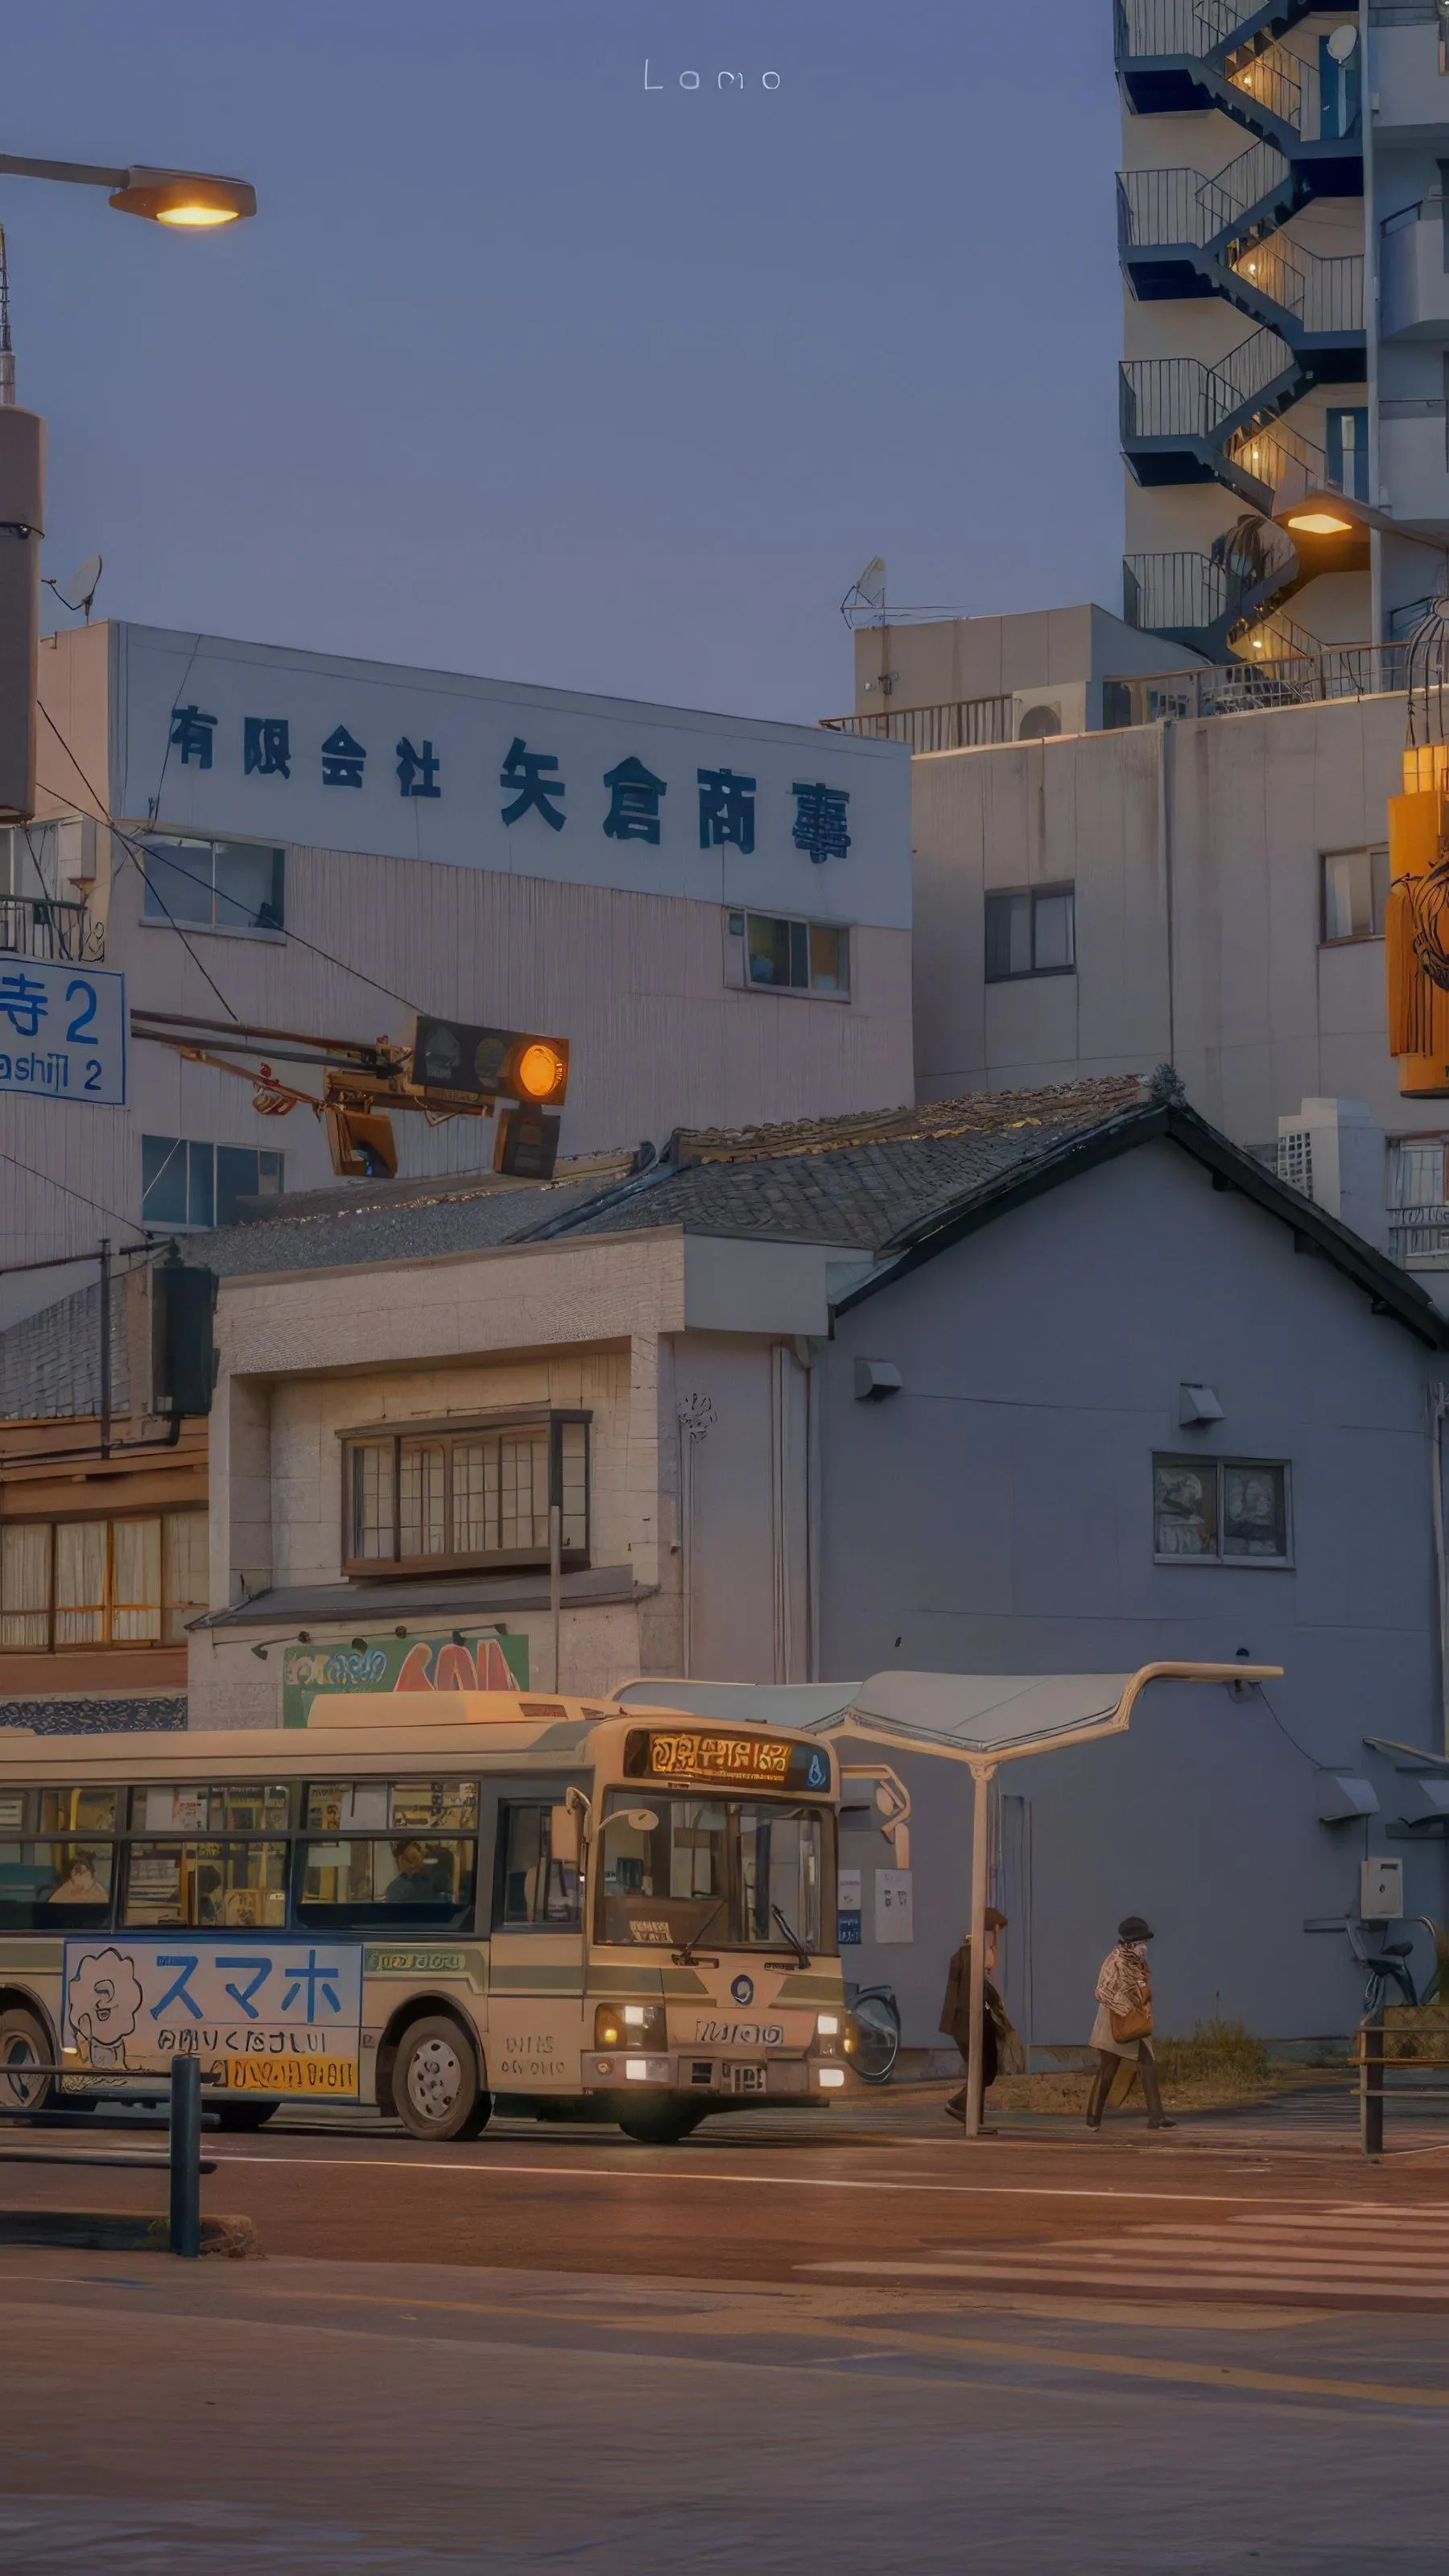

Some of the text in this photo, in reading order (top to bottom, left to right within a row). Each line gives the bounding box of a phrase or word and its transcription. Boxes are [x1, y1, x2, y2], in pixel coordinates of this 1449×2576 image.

[170, 704, 441, 798] 有限会社
[84, 1059, 102, 1091] 2
[150, 1949, 341, 2023] スマホ
